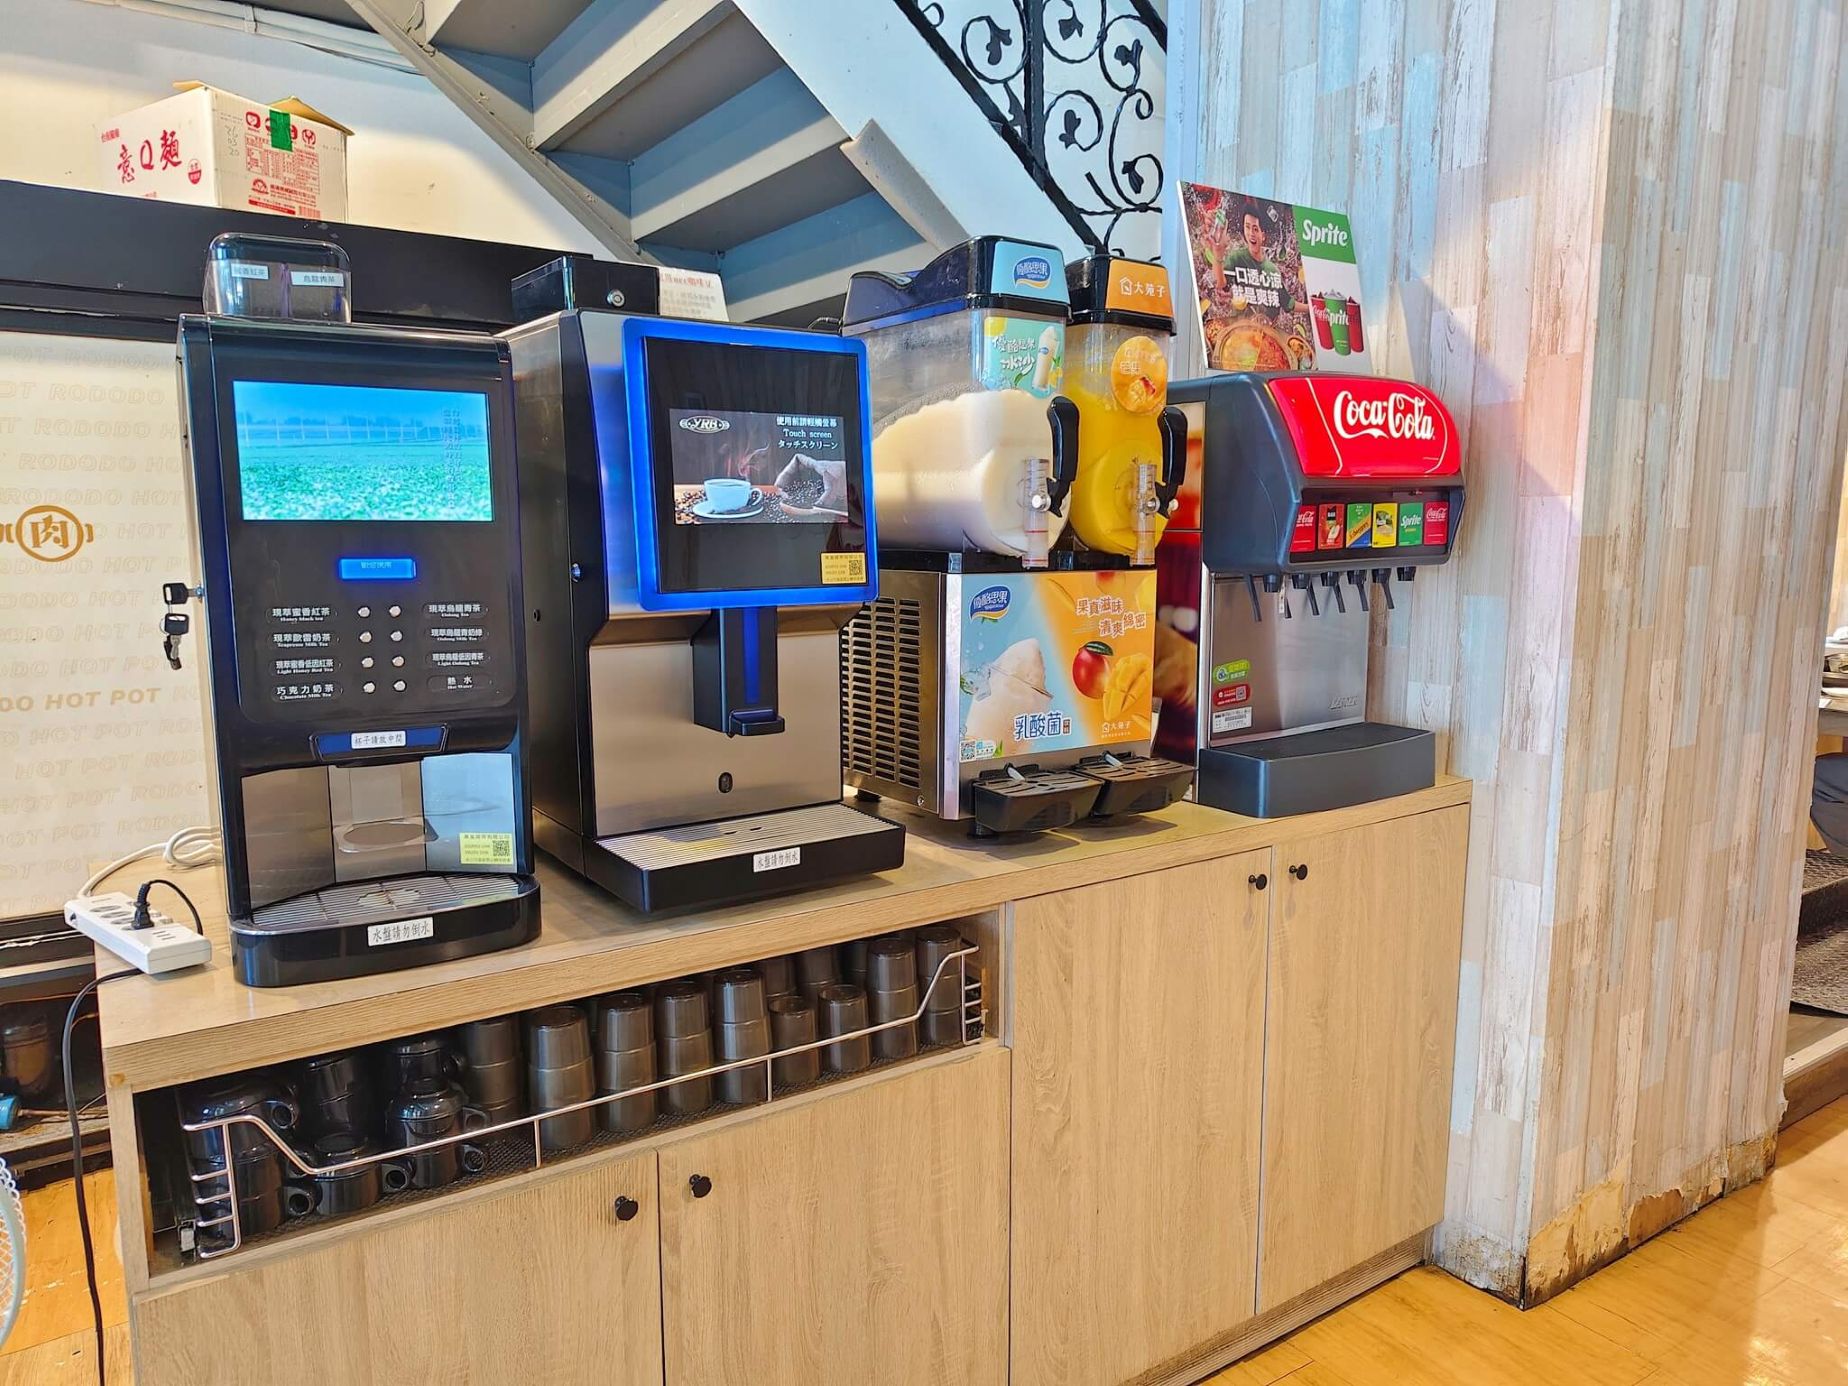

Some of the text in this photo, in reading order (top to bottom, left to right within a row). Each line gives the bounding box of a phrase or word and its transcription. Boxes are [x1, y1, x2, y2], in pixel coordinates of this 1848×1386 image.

[1302, 219, 1348, 247] Sprite
[1134, 282, 1166, 302] 大苑子
[783, 428, 832, 438] Touch screen
[778, 439, 838, 450] タッチスクリーン
[1401, 514, 1422, 529] Sprite
[30, 514, 69, 552] 肉
[1077, 597, 1123, 615] 果真滋味
[463, 675, 473, 684] 水
[44, 691, 101, 711] HOT
[110, 688, 161, 707] POT
[276, 684, 334, 696] 巧克力奶茶
[1014, 712, 1064, 741] 乳酸菌
[373, 920, 430, 943] 水盤請勿倒水
